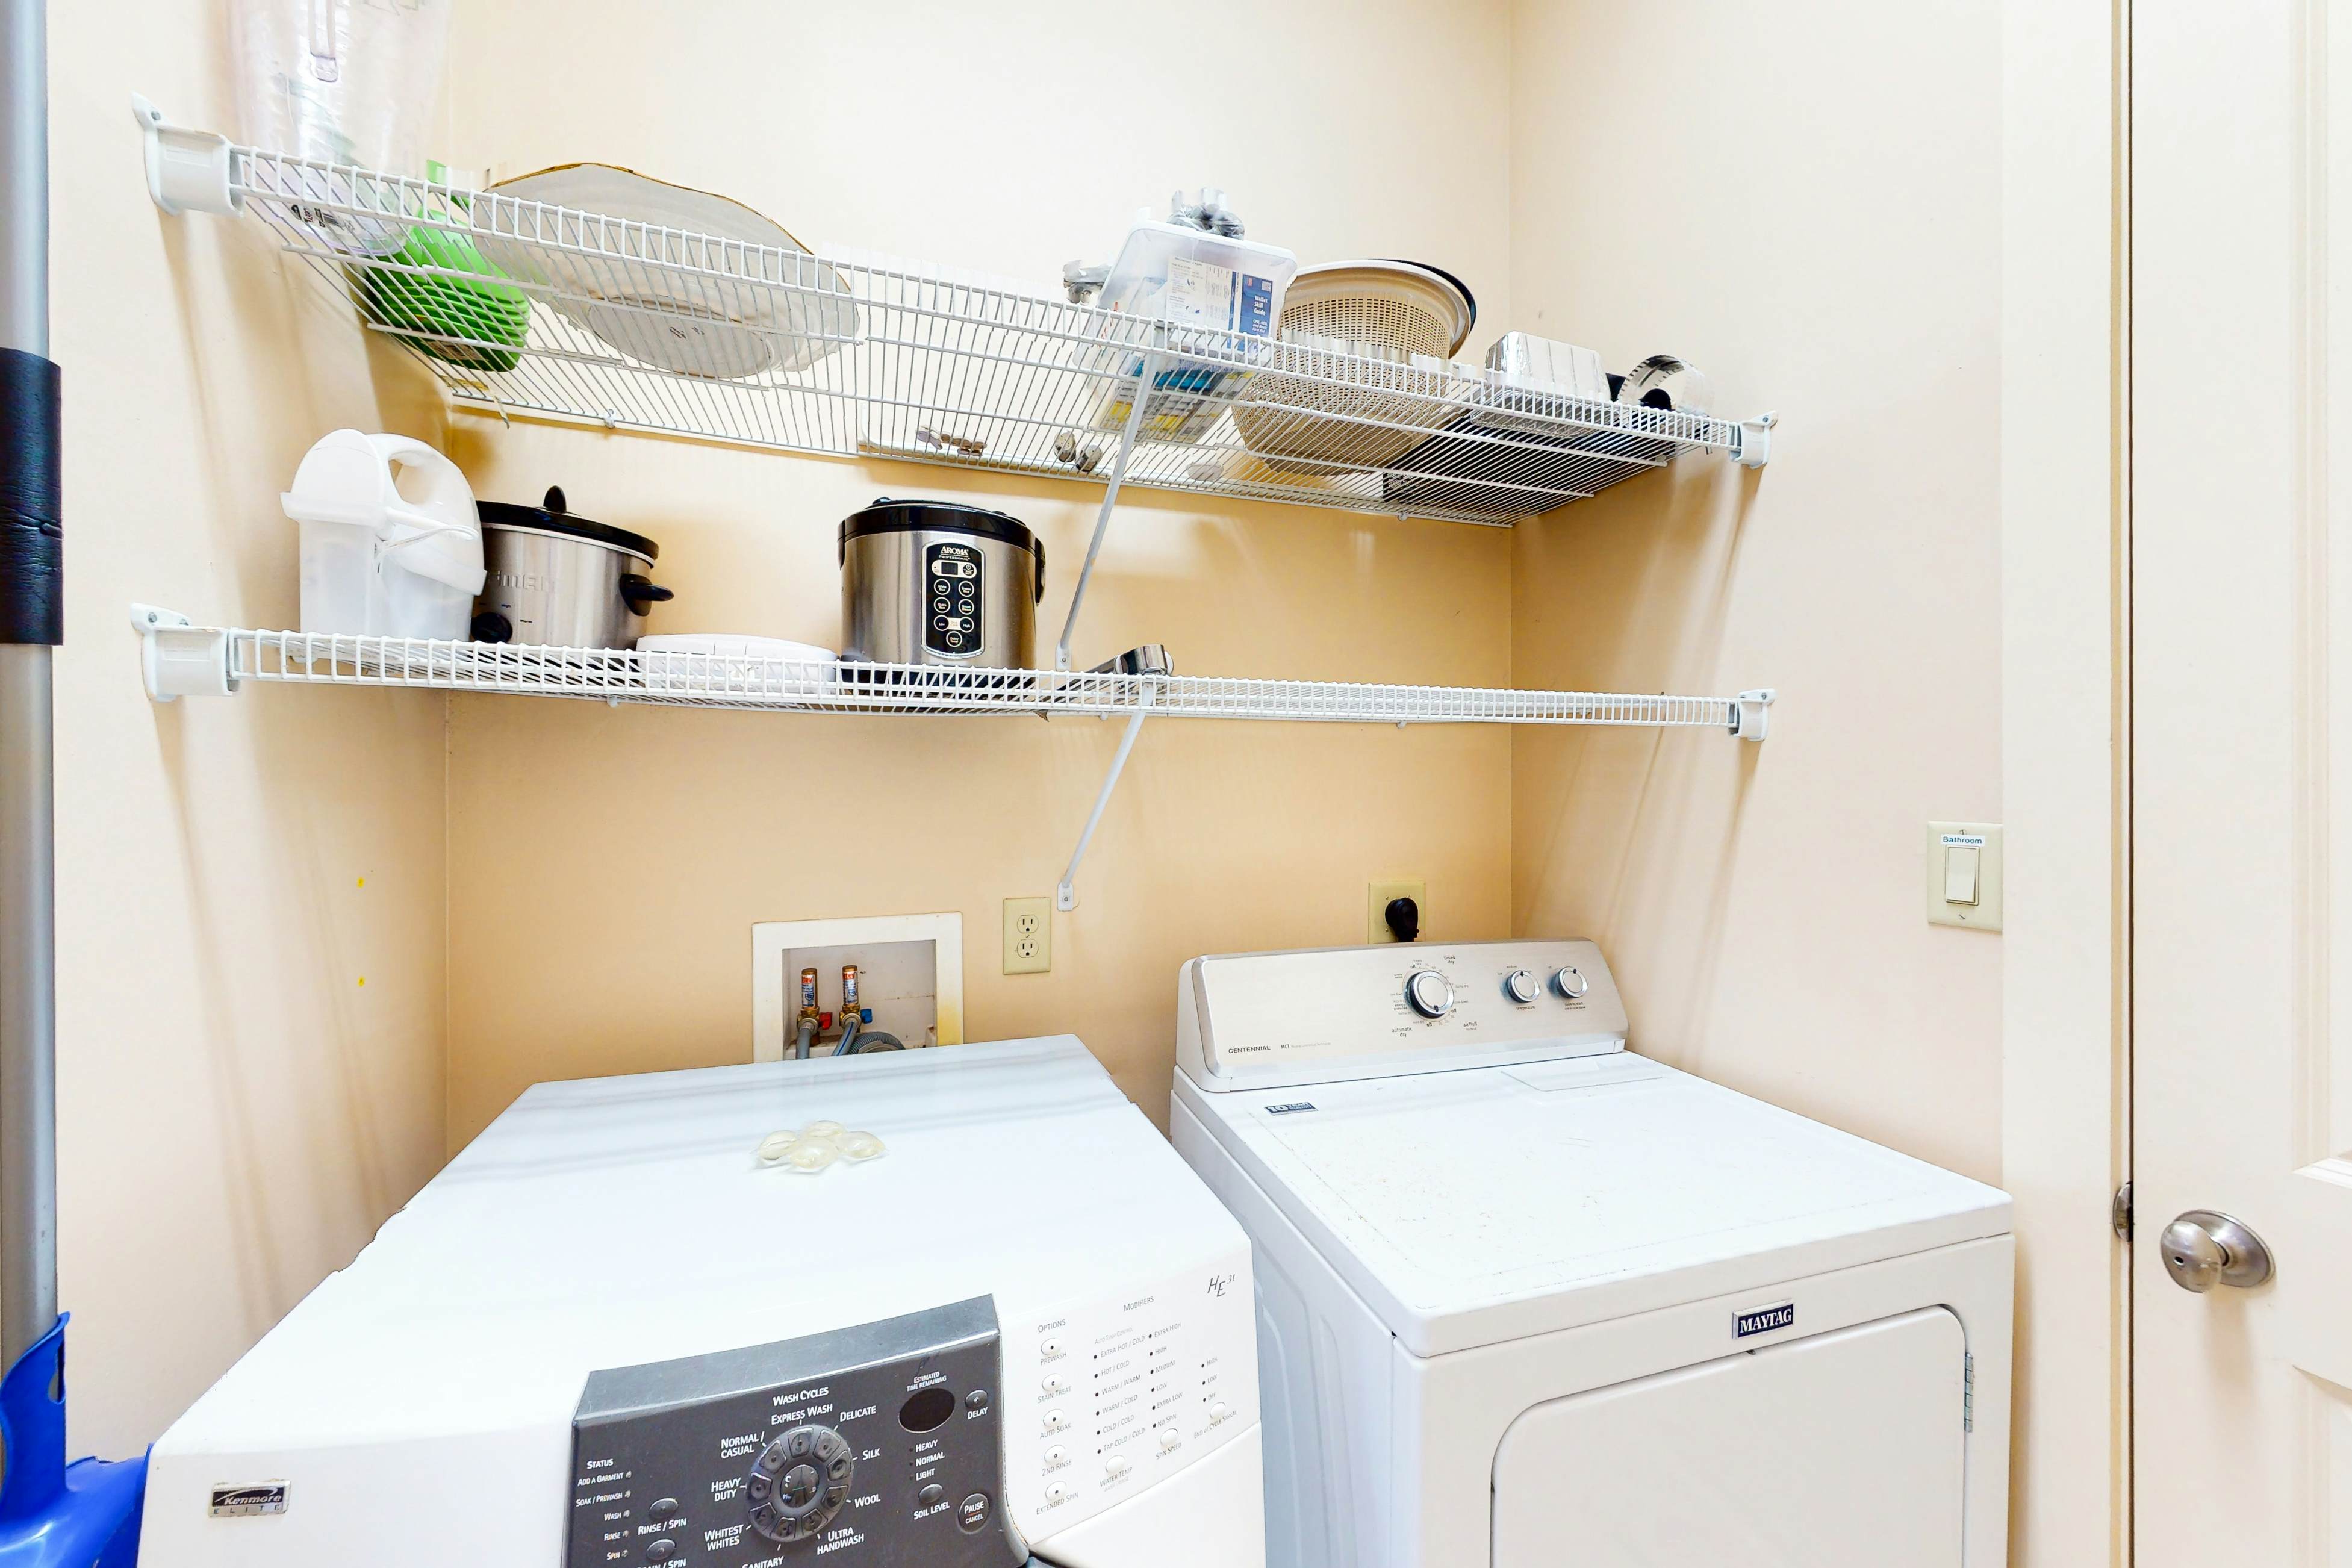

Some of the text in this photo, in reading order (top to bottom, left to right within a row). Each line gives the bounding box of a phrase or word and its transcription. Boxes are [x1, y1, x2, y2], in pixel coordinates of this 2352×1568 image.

[940, 546, 969, 556] AROMA
[1943, 836, 1982, 844] Bathroom
[1228, 1045, 1271, 1054] CENTENNIAL
[1123, 1296, 1154, 1312] MODIFIERS
[1038, 1319, 1066, 1333] OPTIONS
[1740, 1308, 1792, 1333] MAYTAG
[1154, 1322, 1181, 1338] EXTRA HIGH
[1101, 1347, 1116, 1358] EXTRA
[1118, 1342, 1128, 1351] HOT
[1132, 1336, 1145, 1345] COLD
[1155, 1346, 1167, 1355] HIGH
[1041, 1352, 1066, 1366] PREWASH
[1156, 1360, 1175, 1373] MEDIUM
[1101, 1367, 1112, 1376] HOT
[1116, 1360, 1130, 1370] COLD
[907, 1375, 947, 1392] TIME REMAINING
[913, 1371, 940, 1383] ESTIMATED
[1101, 1384, 1119, 1395] WARM
[1124, 1375, 1141, 1386] WARM
[1156, 1382, 1168, 1391] LOW
[773, 1387, 829, 1407] WASH CYCLES
[1038, 1386, 1072, 1404] STAIN TREAT
[1157, 1392, 1183, 1408] EXTRA LOW
[1102, 1403, 1119, 1414] WARM
[1124, 1395, 1137, 1405] COLD
[771, 1404, 833, 1425] EXPRESS WASH
[839, 1405, 877, 1422] DELICATE
[967, 1407, 988, 1420] DELAY
[1040, 1423, 1072, 1439] AUTO SOAK
[1103, 1423, 1116, 1433] COLD
[1121, 1415, 1134, 1425] COLD
[1194, 1430, 1203, 1439] END
[1209, 1418, 1222, 1430] CYCLE
[721, 1433, 758, 1448] NORMAL
[1114, 1436, 1127, 1446] COLD
[1132, 1428, 1145, 1438] COLD
[721, 1445, 754, 1459] CASUAL
[915, 1439, 938, 1452] HEAVY
[1168, 1442, 1181, 1454] SPEED
[862, 1448, 880, 1460] SILK
[915, 1451, 945, 1467] NORMAL
[586, 1458, 614, 1469] STATUS
[1042, 1459, 1072, 1476] 2ND RINSE
[577, 1478, 590, 1487] ADD
[597, 1472, 624, 1482] GARMENT
[916, 1469, 935, 1481] LIGHT
[1100, 1475, 1118, 1487] WATER
[711, 1477, 741, 1493] HEAVY
[224, 1495, 282, 1505] Kenmore
[576, 1498, 591, 1507] SOAK
[596, 1492, 623, 1502] PREWASH
[714, 1489, 737, 1502] DUTY
[854, 1494, 881, 1508] WOOL
[213, 1505, 280, 1514] ELITE
[913, 1501, 950, 1520] SOIL LEVEL
[964, 1501, 985, 1514] PAUSE
[1036, 1492, 1078, 1515] EXTENDED SPIN
[604, 1512, 621, 1521] WASH
[965, 1513, 983, 1524] CANCEL
[638, 1523, 662, 1535] RINSE
[668, 1518, 687, 1529] SPIN
[704, 1524, 744, 1542] WHITEST
[827, 1526, 854, 1542] ULTRA
[604, 1532, 621, 1541] RINSE
[707, 1535, 740, 1551] WHITES
[817, 1533, 865, 1555] HANDWASH
[606, 1552, 620, 1560] SPIN
[668, 1558, 686, 1568] SPIN
